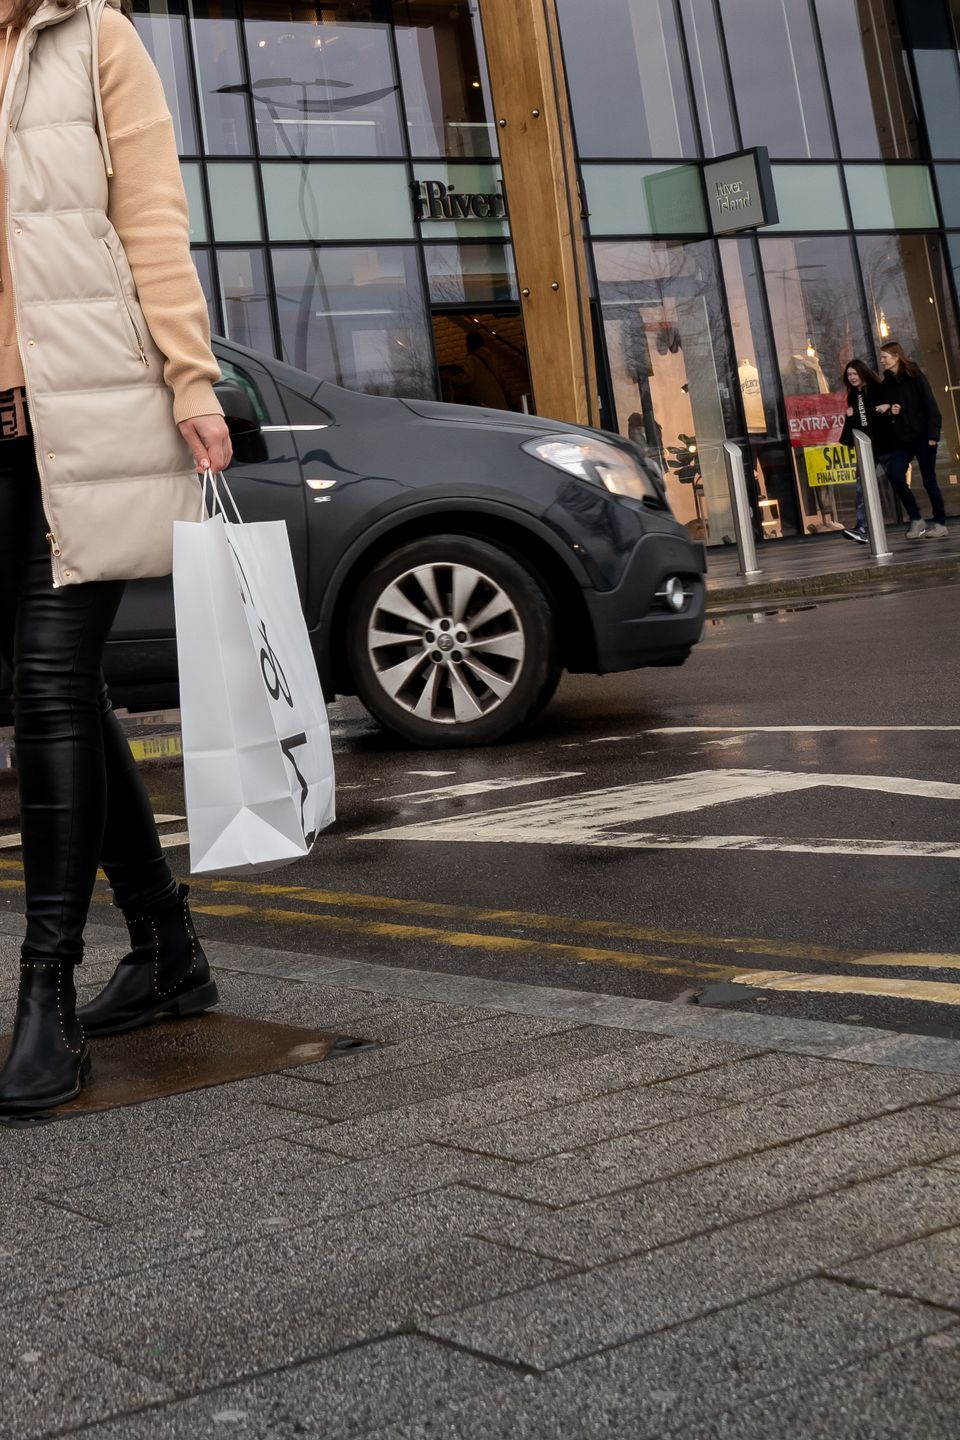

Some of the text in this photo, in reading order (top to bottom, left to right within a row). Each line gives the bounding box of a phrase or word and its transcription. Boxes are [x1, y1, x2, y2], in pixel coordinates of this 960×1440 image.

[715, 180, 743, 198] River
[716, 191, 752, 214] Island
[789, 415, 830, 433] EXTRA
[823, 446, 857, 470] SALE
[816, 471, 835, 484] FINAL
[836, 470, 851, 482] FEW
